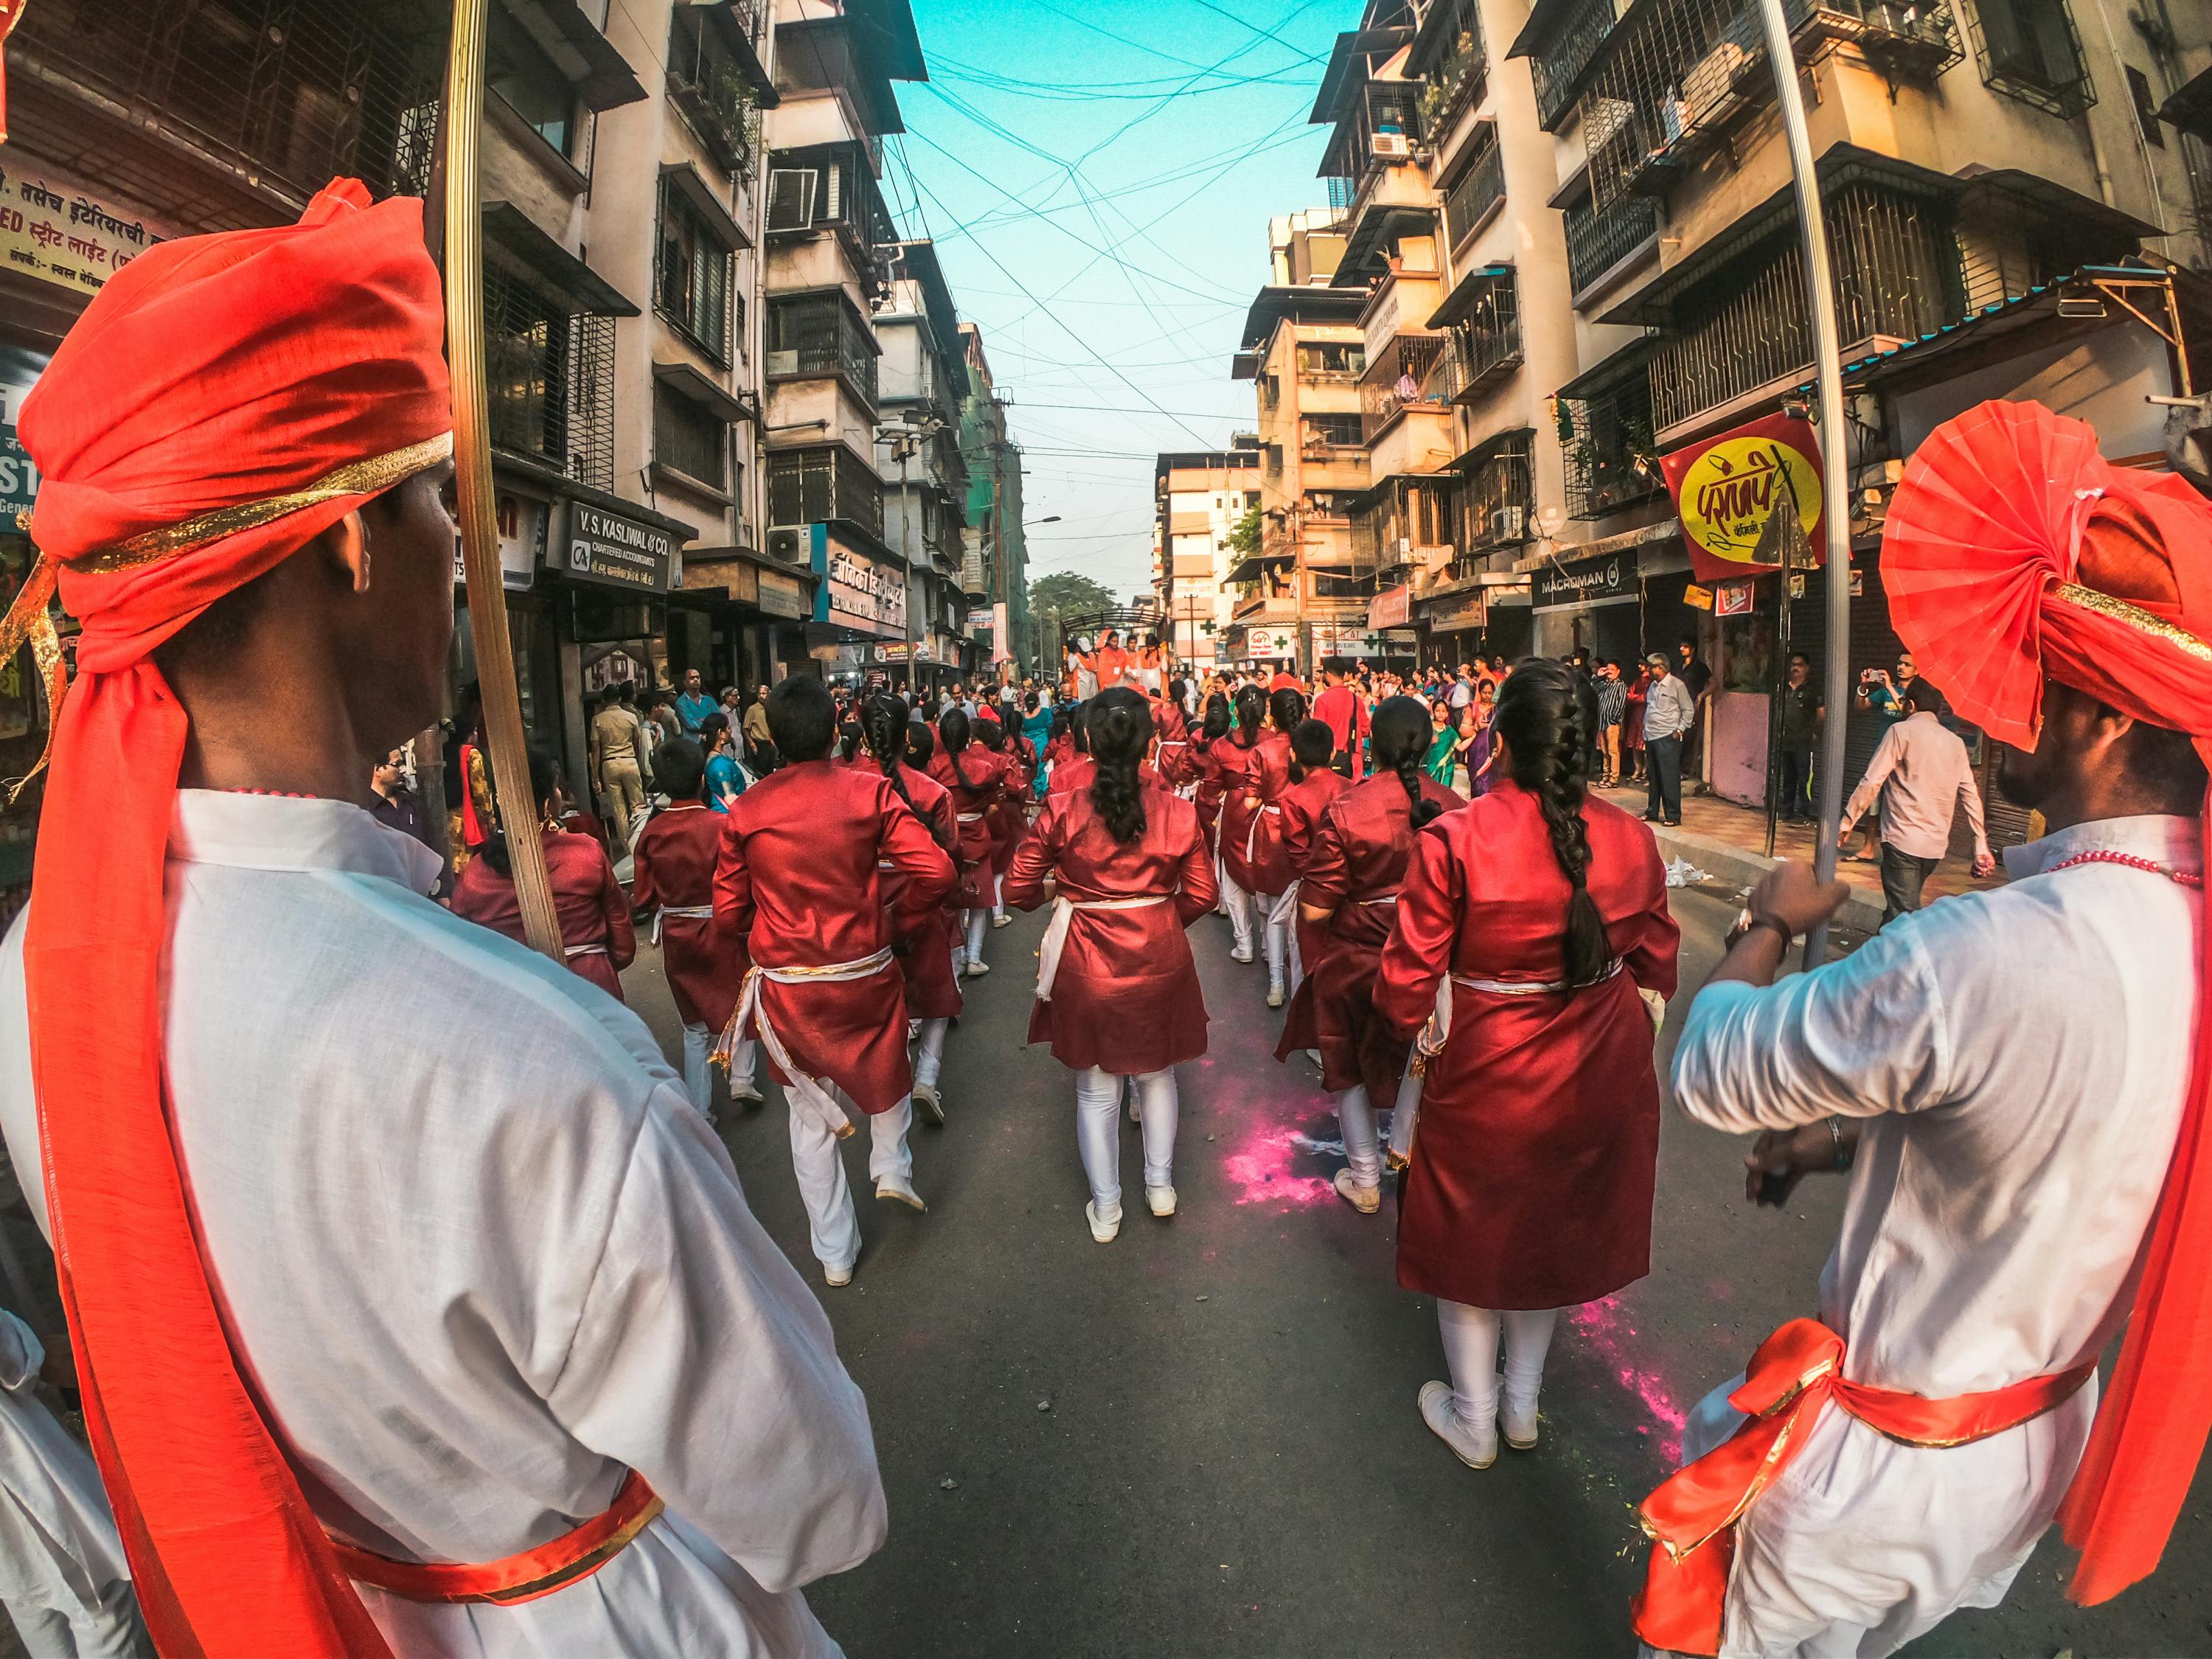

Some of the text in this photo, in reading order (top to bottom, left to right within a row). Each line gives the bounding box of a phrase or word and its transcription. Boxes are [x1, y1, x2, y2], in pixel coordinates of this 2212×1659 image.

[21, 180, 65, 214] तसेच
[68, 237, 108, 263] लाईट
[580, 510, 668, 556] V. S. KASLIWAL & CO.
[592, 541, 655, 567] CHARTERED ACCOUNTANTS
[1542, 571, 1604, 594] MACROMAN
